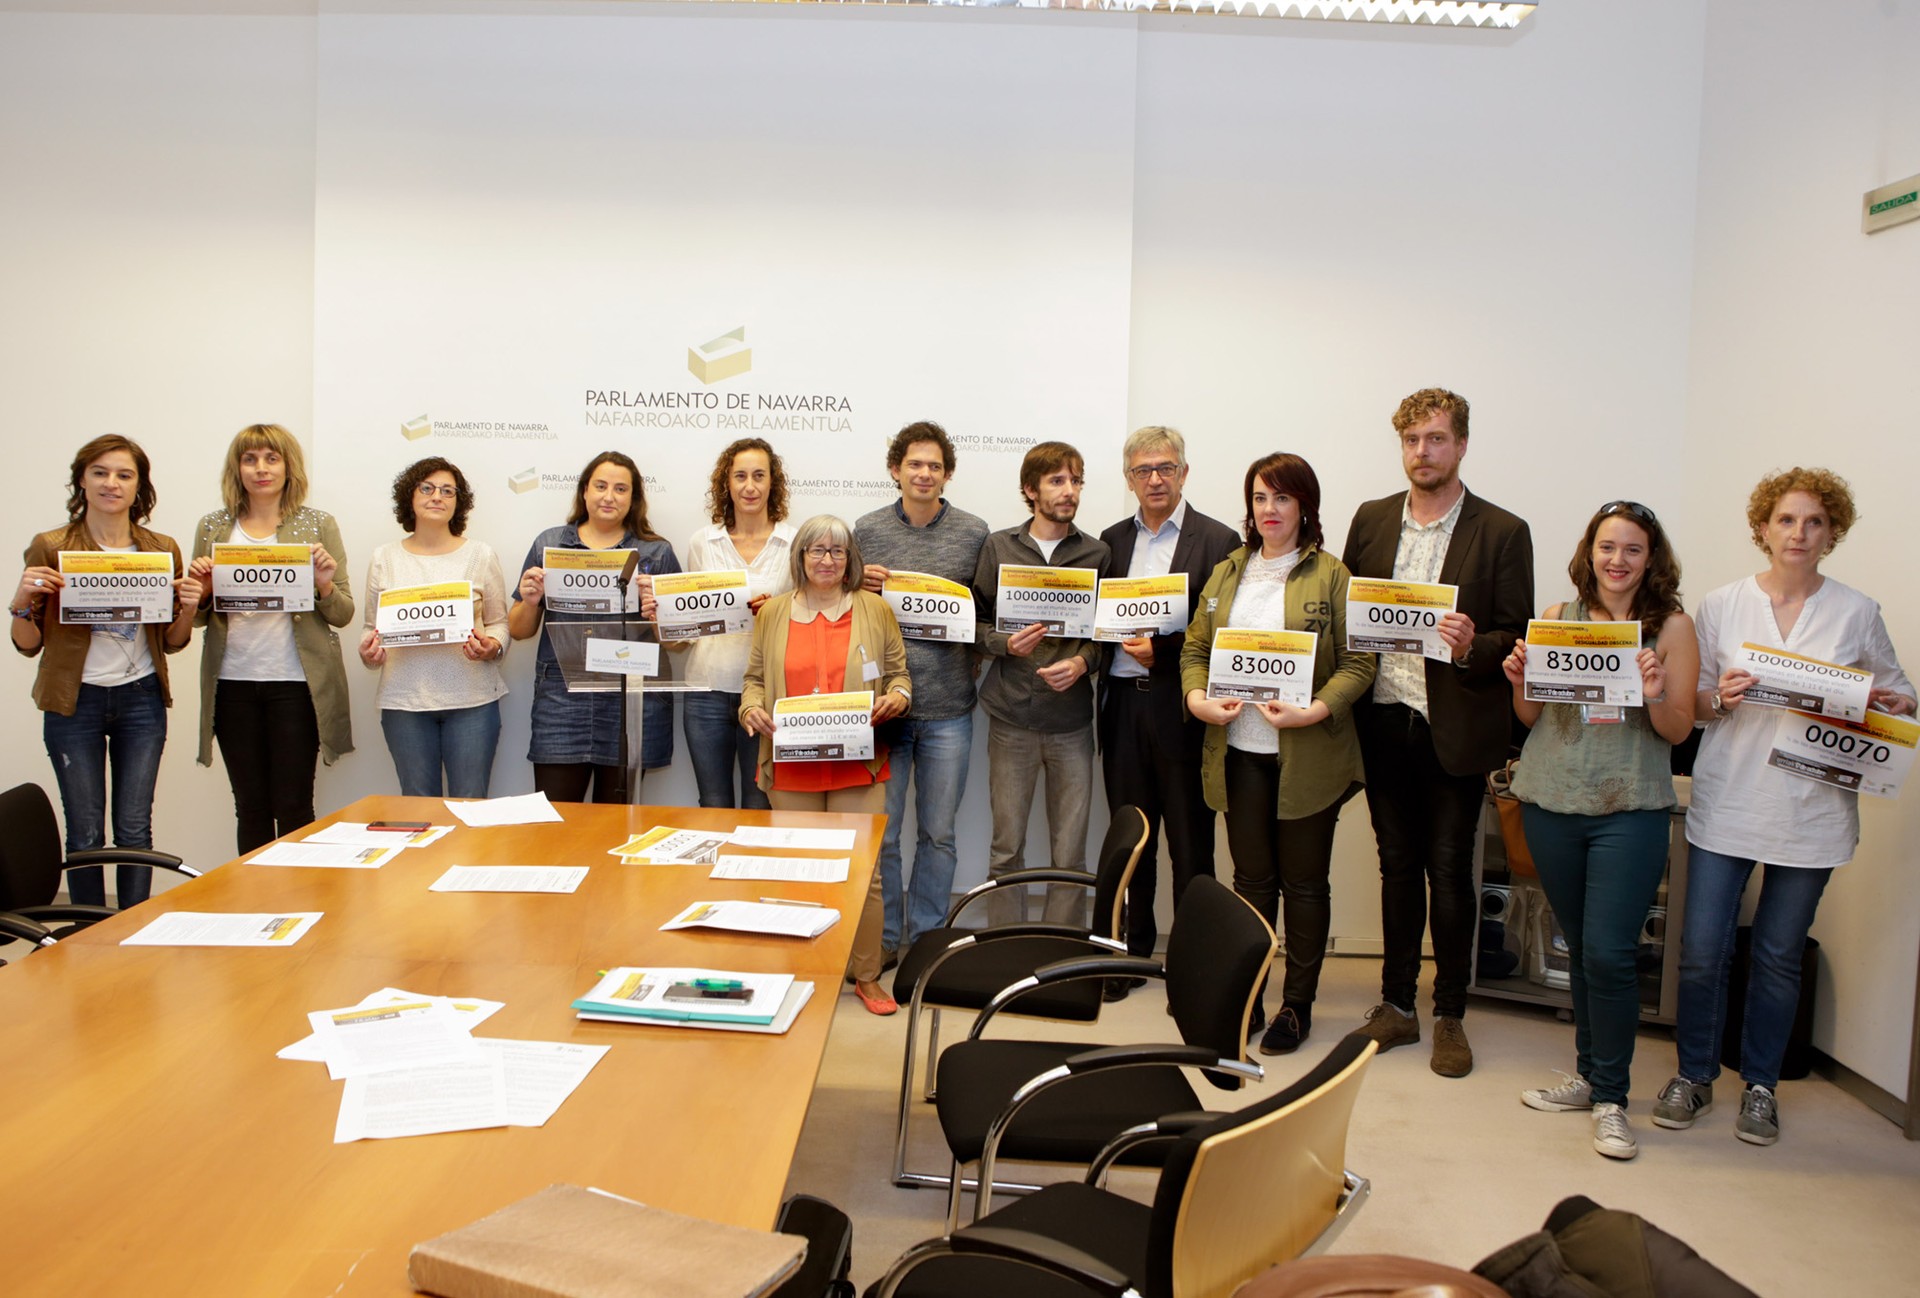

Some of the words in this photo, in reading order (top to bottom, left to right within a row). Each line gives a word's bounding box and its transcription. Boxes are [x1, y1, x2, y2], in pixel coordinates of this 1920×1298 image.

[586, 390, 718, 409] PARLAMENTO
[727, 394, 750, 410] DE
[759, 394, 852, 412] NAVARRA
[434, 422, 492, 430] PARLAMENTO
[585, 411, 710, 429] NAFARROAKO
[717, 414, 852, 432] PARLAMENTUA
[70, 576, 168, 588] 1000000000
[234, 569, 296, 584] 00070
[564, 574, 619, 588] 00001
[675, 592, 735, 611] 00070
[902, 596, 960, 614] 83000
[1006, 590, 1090, 604] 1000000000
[397, 605, 456, 620] 00001
[1117, 601, 1171, 617] 00001
[1369, 607, 1436, 627] 00070
[1232, 654, 1295, 676] 83000
[1547, 651, 1620, 672] 83000
[1747, 652, 1864, 682] 1000000000
[782, 714, 868, 727] 1000000000
[1805, 725, 1890, 763] 00070
